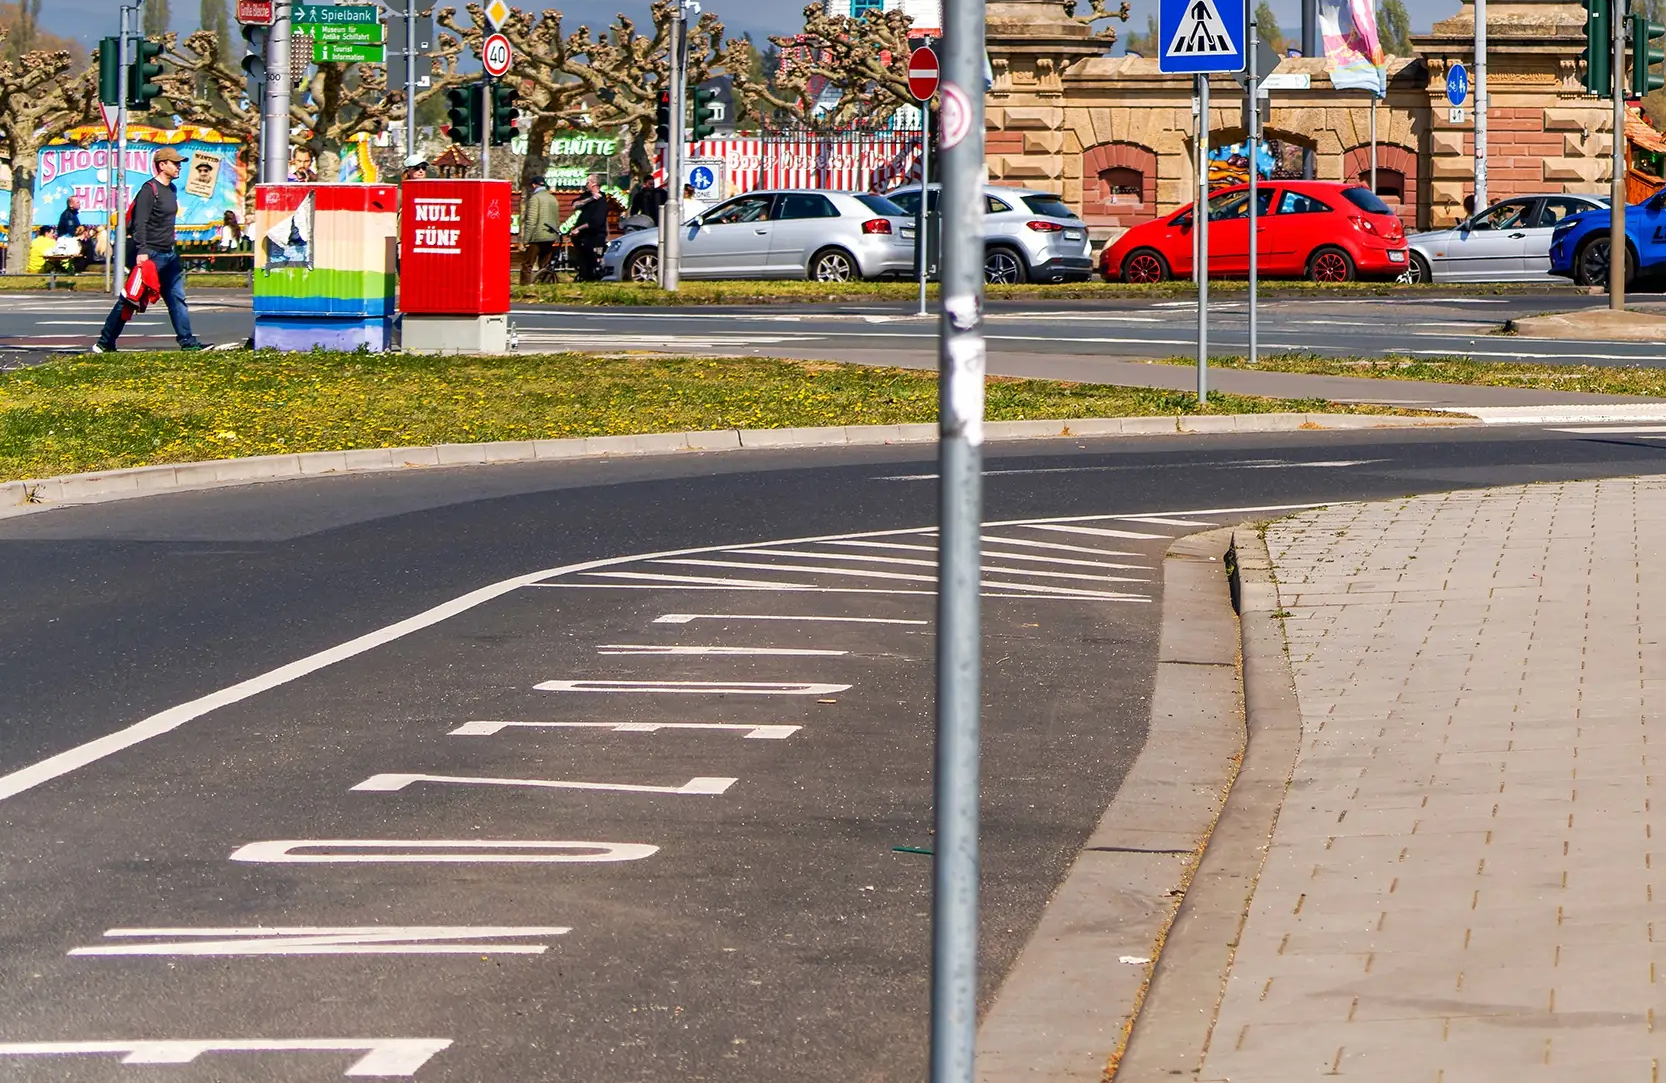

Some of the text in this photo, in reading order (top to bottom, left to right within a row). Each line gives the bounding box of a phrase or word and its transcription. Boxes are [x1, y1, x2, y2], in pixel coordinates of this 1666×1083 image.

[321, 9, 371, 22] Spielbank
[348, 25, 357, 33] für
[332, 45, 353, 53] Tourist
[490, 45, 506, 64] 40
[331, 53, 365, 61] Information
[415, 204, 461, 222] NULL
[415, 226, 461, 246] FÜNF
